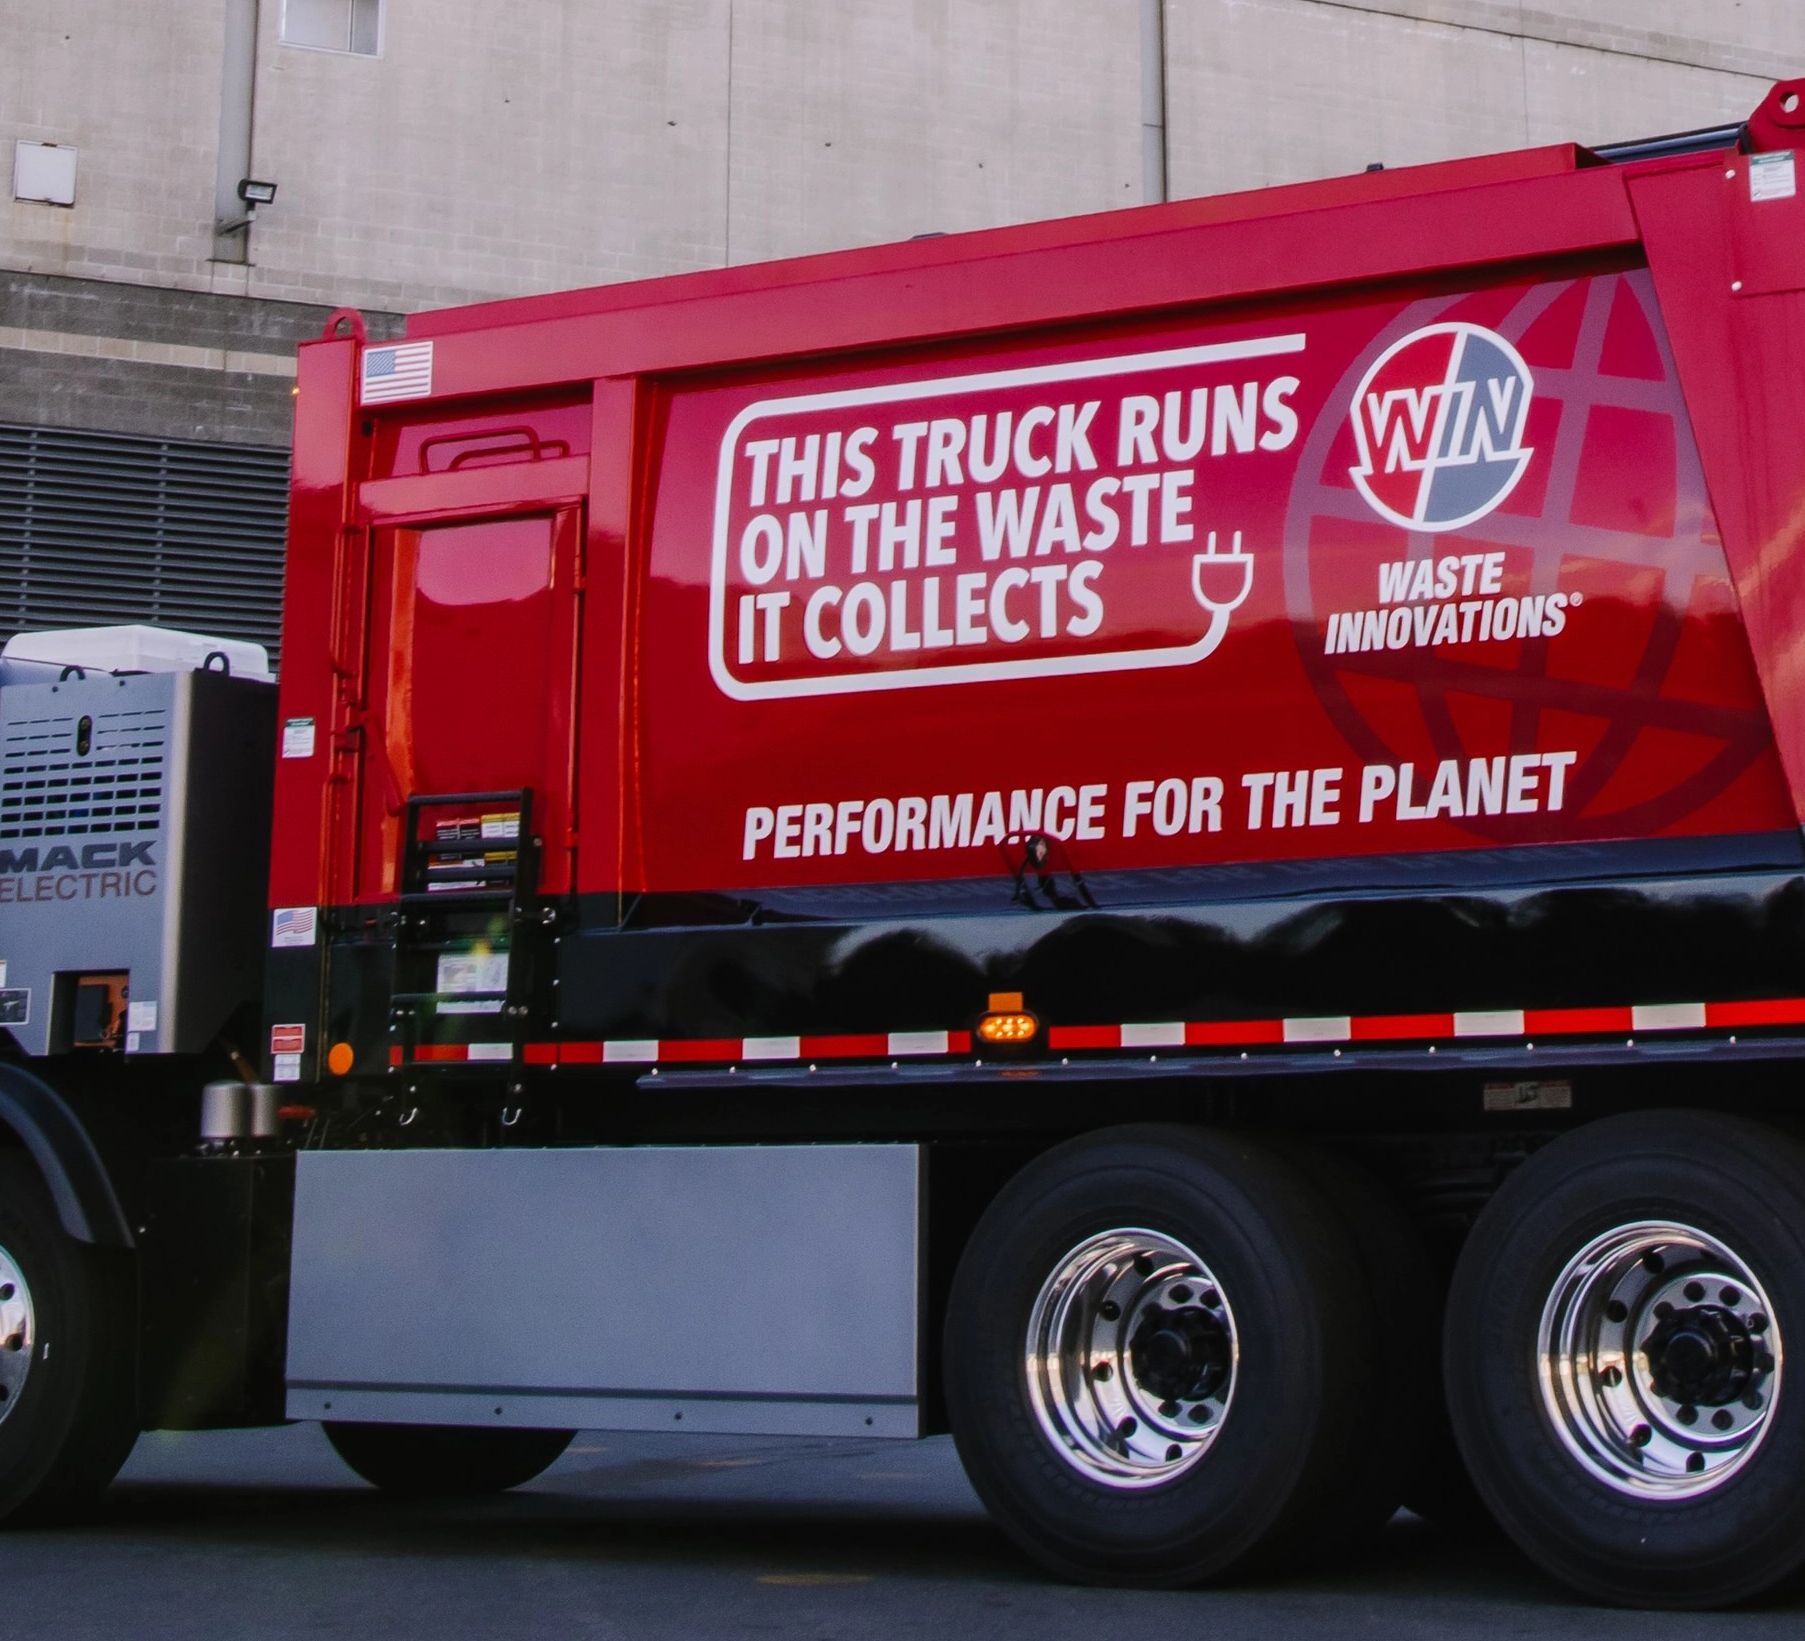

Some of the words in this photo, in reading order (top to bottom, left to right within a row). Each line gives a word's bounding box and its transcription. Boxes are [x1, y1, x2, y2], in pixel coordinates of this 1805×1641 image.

[745, 426, 879, 507] THIS
[892, 401, 1102, 491] TRUCK
[1117, 376, 1301, 467] RUNS
[1356, 374, 1528, 474] WIN
[740, 508, 828, 586] ON
[844, 495, 959, 575] THE
[975, 469, 1195, 562] WASTE
[1378, 551, 1506, 604] WASTE
[738, 592, 790, 664] IT
[803, 559, 1105, 660] COLLECTS
[742, 783, 1110, 861] PERFORMANCE
[1122, 776, 1224, 837] FOR
[1241, 767, 1343, 829] THE
[1358, 751, 1577, 824] PLANET
